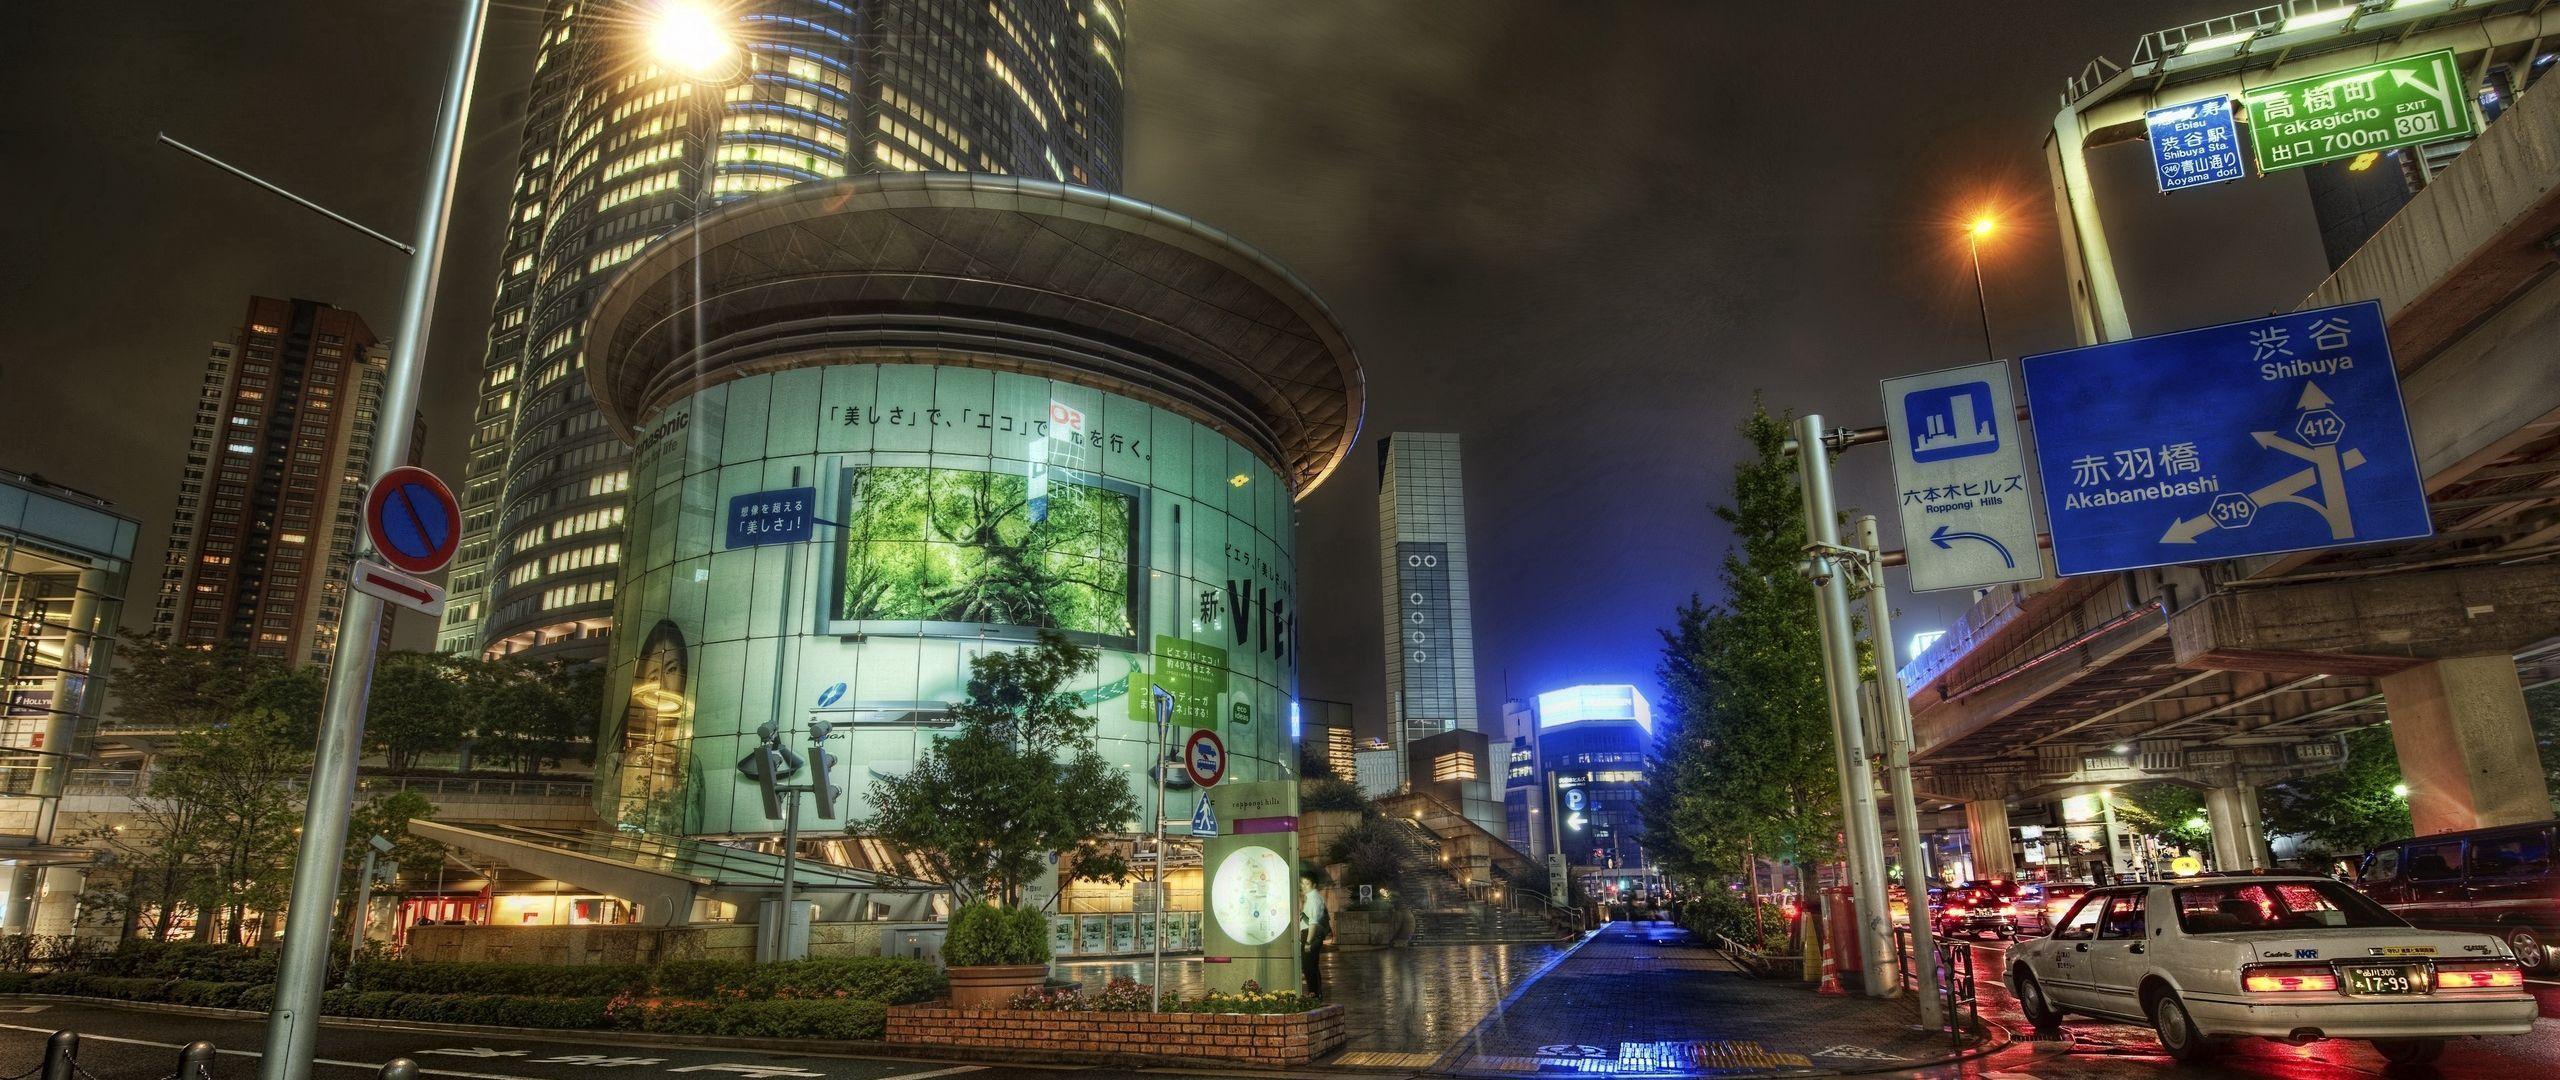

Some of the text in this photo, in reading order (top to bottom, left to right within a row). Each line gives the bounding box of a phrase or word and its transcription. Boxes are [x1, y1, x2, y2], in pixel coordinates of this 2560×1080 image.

[2263, 78, 2376, 122] 高樹町
[2396, 99, 2428, 113] EXIT
[2175, 120, 2206, 131] Ebisu
[2267, 106, 2380, 138] Takagicho
[2397, 112, 2438, 135] 301
[2162, 127, 2228, 152] 渋谷駅
[2271, 126, 2390, 163] 出口 700m
[2164, 143, 2229, 160] Shibuya Sta.
[2164, 152, 2236, 175] 246 青山通り
[2167, 167, 2237, 187] Aoyama dori
[2250, 316, 2352, 362] 渋谷
[2260, 353, 2354, 382] Shibuya
[2303, 416, 2337, 437] 412
[2071, 442, 2202, 489] 赤羽橋
[1903, 474, 2023, 506] 六本木ヒルズ
[2064, 475, 2220, 512] Akabanebashi
[740, 501, 803, 518] 想像を超える
[1926, 496, 2003, 514] Roppongi Hills
[2215, 501, 2250, 522] 319
[2365, 977, 2409, 991] 17-99
